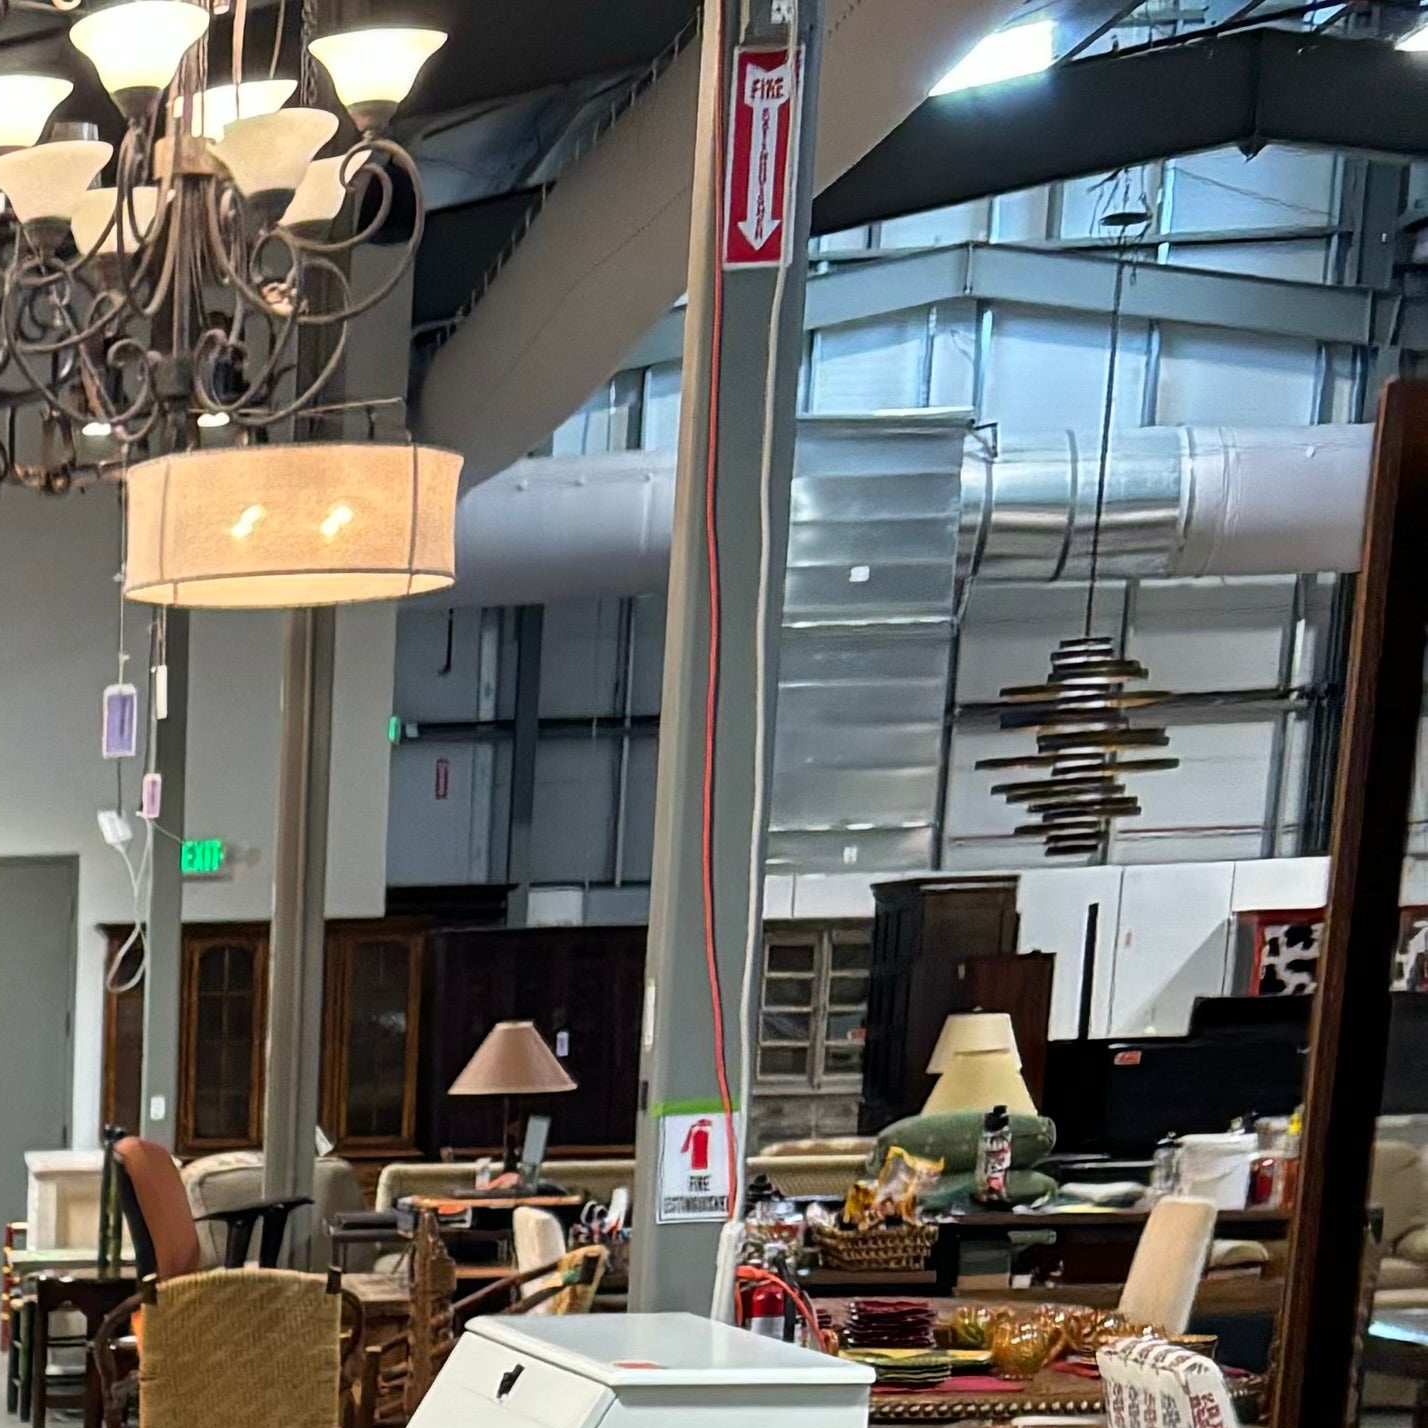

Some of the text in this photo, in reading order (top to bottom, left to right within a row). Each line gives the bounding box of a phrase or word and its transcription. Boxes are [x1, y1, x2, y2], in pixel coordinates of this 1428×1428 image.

[751, 77, 784, 100] FIRE
[182, 841, 220, 871] EXIT
[689, 1175, 711, 1191] FIRE
